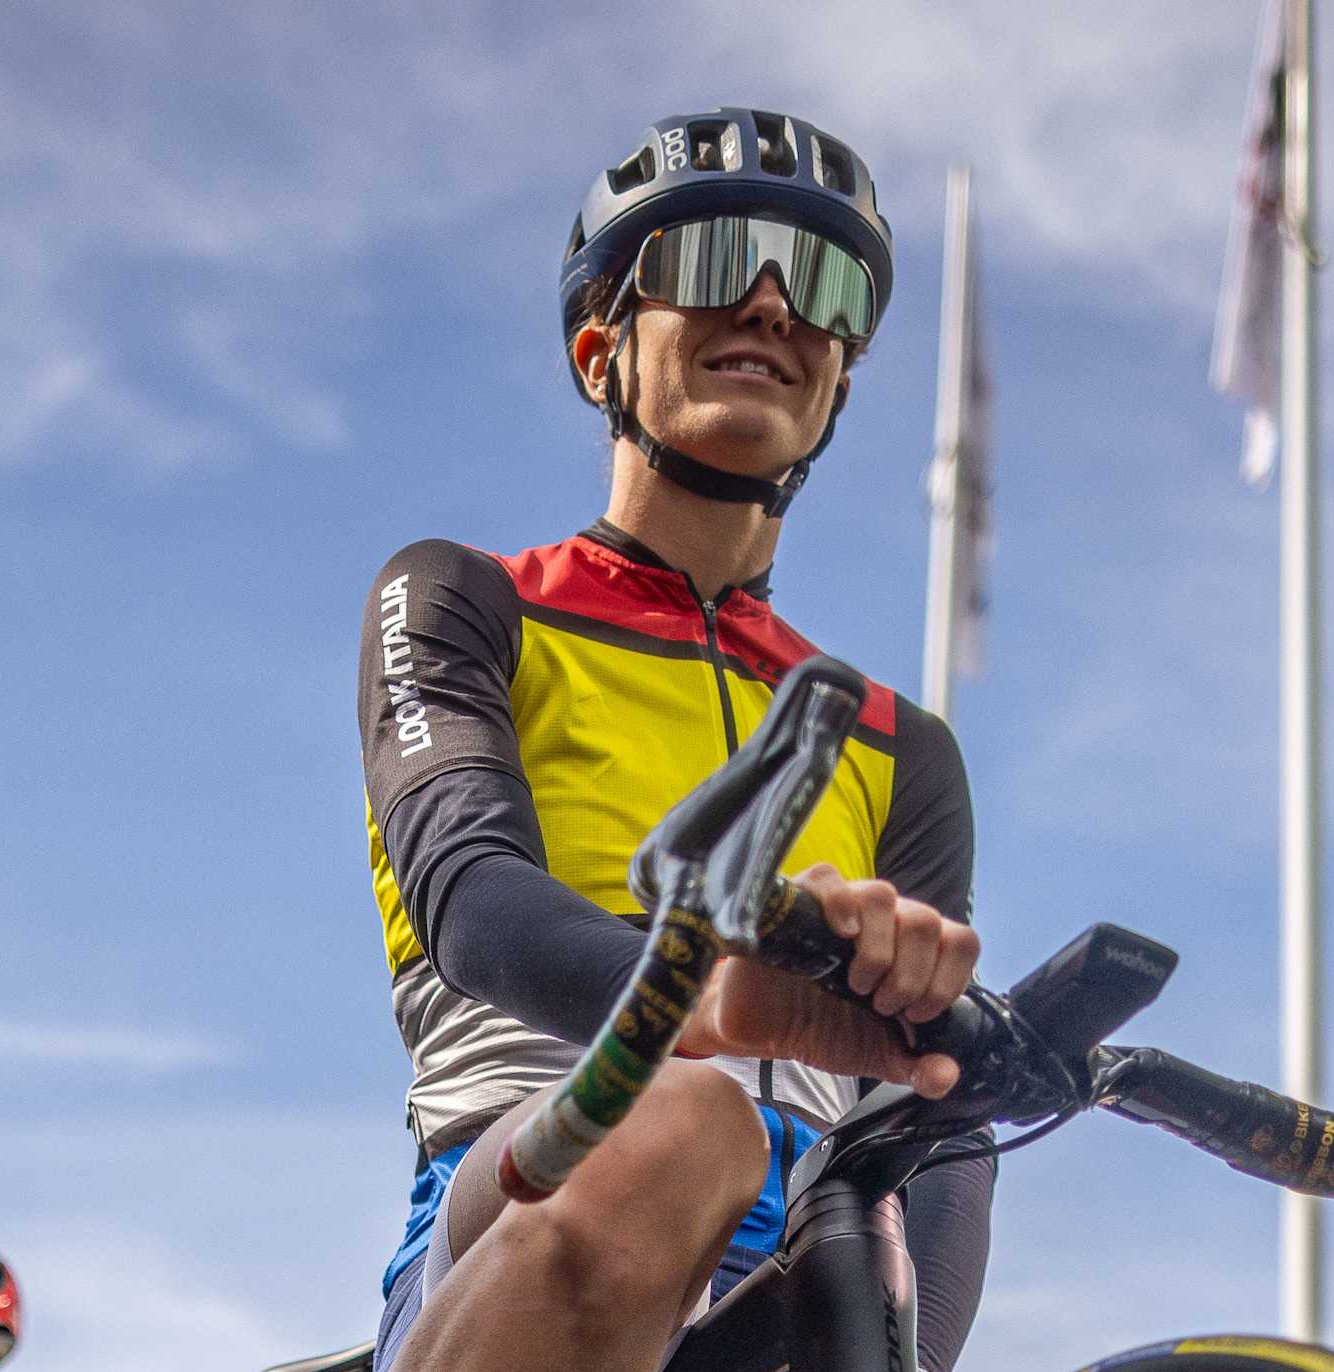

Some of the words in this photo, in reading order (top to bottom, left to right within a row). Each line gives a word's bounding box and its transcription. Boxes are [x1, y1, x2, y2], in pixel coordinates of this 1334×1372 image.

[661, 127, 687, 171] POC
[380, 573, 414, 676] ITALIA
[388, 679, 433, 758] LOOK
